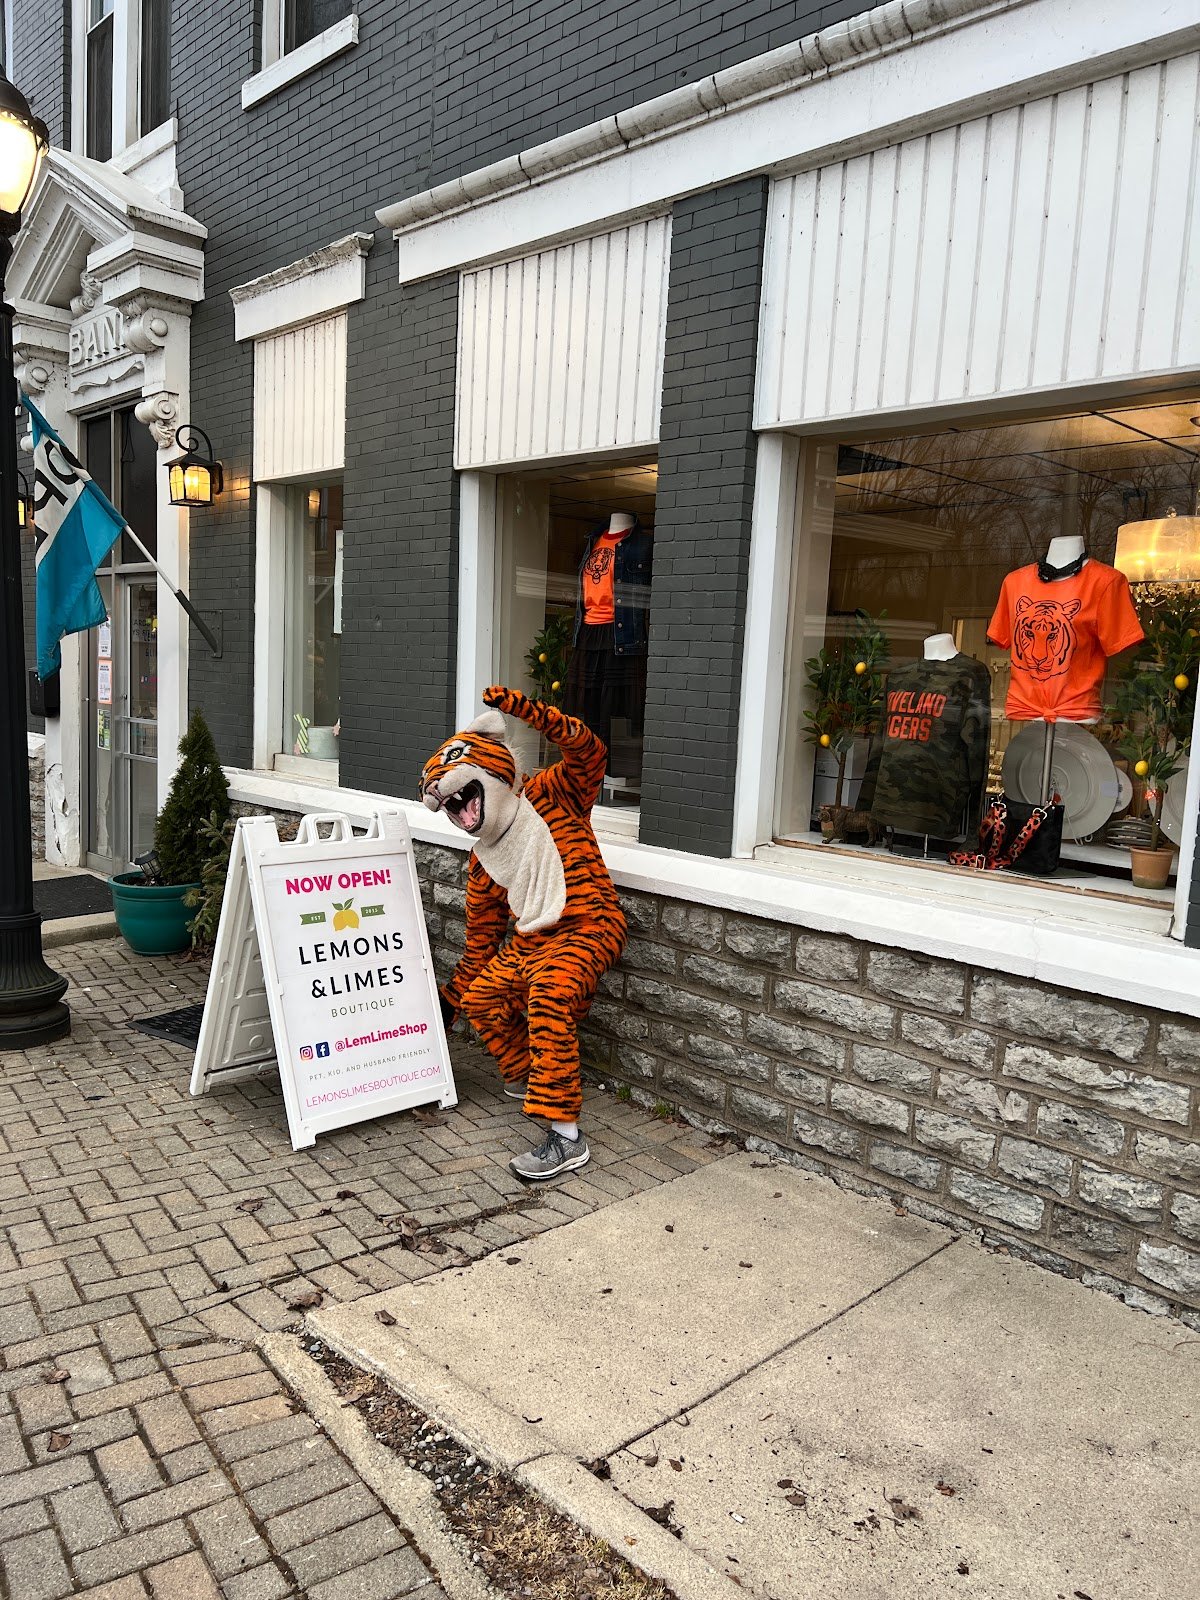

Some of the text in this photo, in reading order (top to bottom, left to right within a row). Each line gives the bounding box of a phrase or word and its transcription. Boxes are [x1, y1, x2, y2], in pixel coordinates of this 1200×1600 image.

[69, 311, 127, 367] BAN
[285, 869, 392, 895] NOW OPEN!
[299, 932, 403, 965] LEMONS
[311, 965, 404, 998] &LIMES
[331, 997, 395, 1018] BOUTIQUE
[335, 1023, 428, 1052] @LemLimeShop
[346, 1064, 361, 1072] AND
[363, 1055, 397, 1068] HUSBAND
[398, 1047, 431, 1060] FRIENDLY
[306, 1065, 441, 1108] LEMONSLIMESBOUTIQUE.COM
